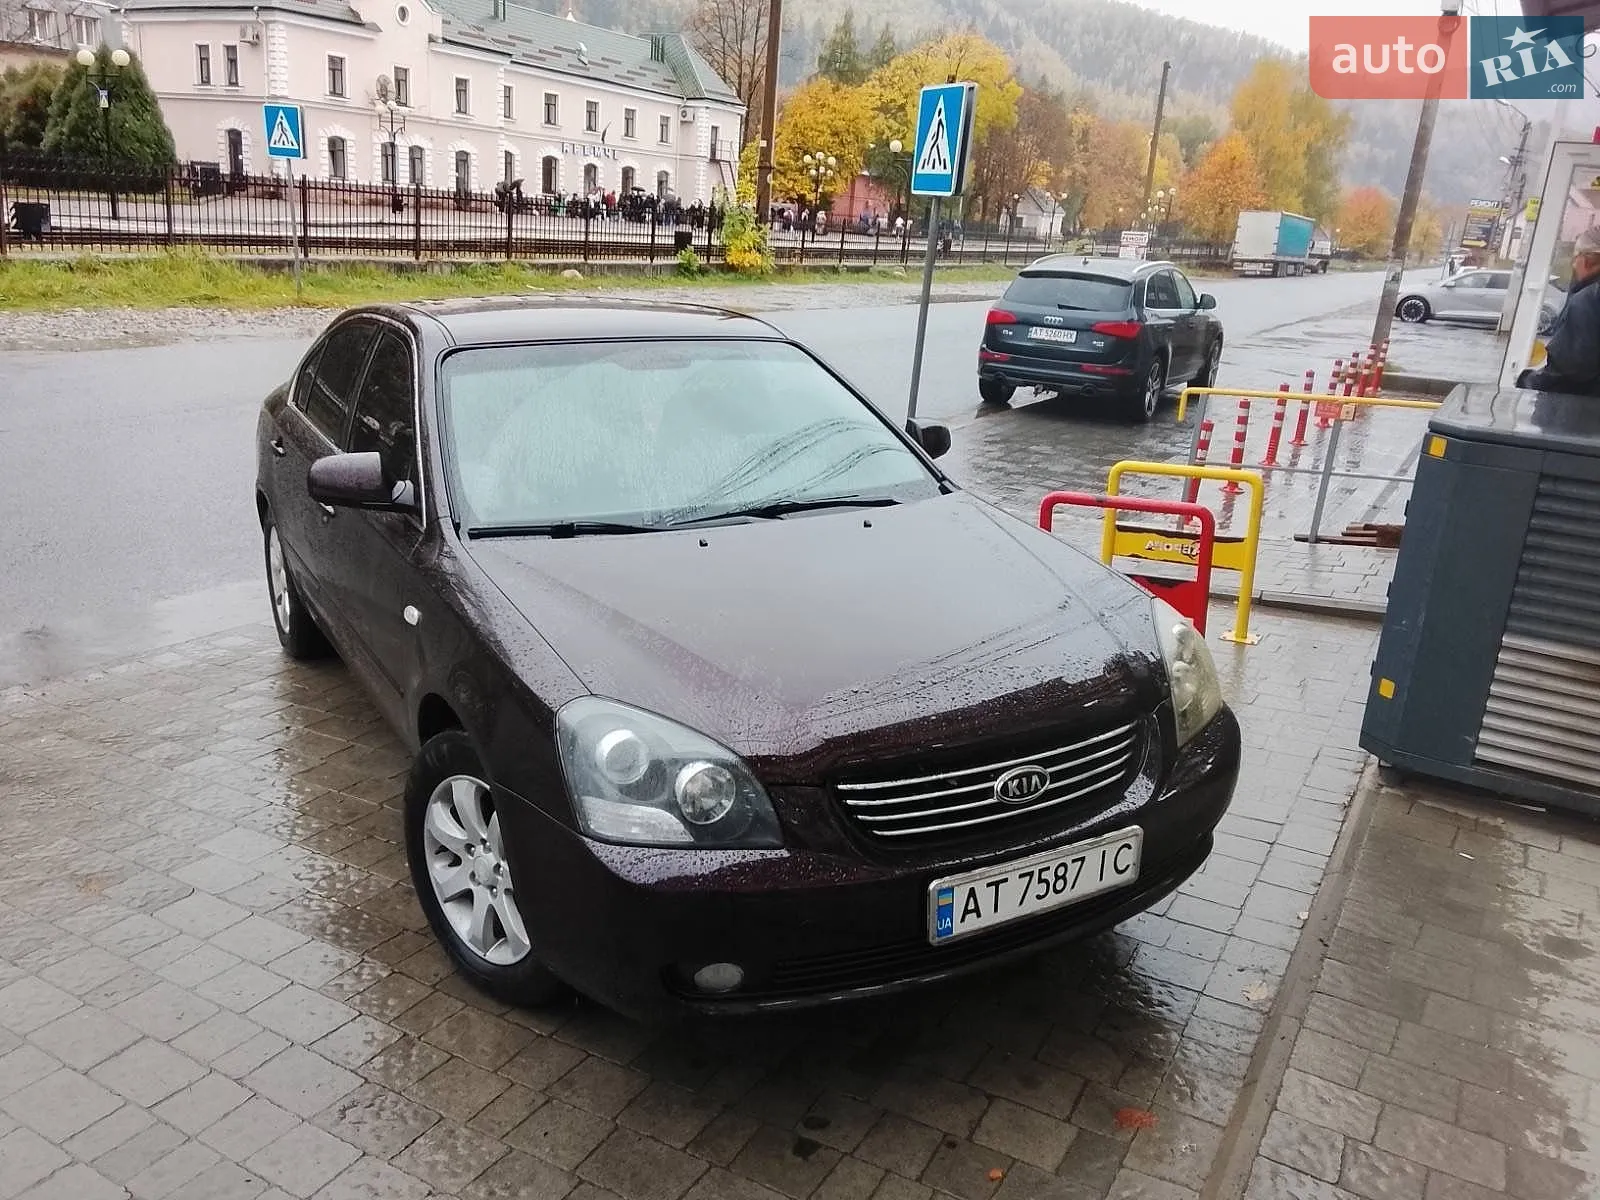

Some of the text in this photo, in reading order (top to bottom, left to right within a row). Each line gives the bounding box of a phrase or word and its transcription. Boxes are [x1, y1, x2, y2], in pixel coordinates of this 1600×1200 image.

[1007, 774, 1043, 797] KIA
[960, 843, 1133, 923] AT 7587 IC
[937, 917, 952, 931] UA
